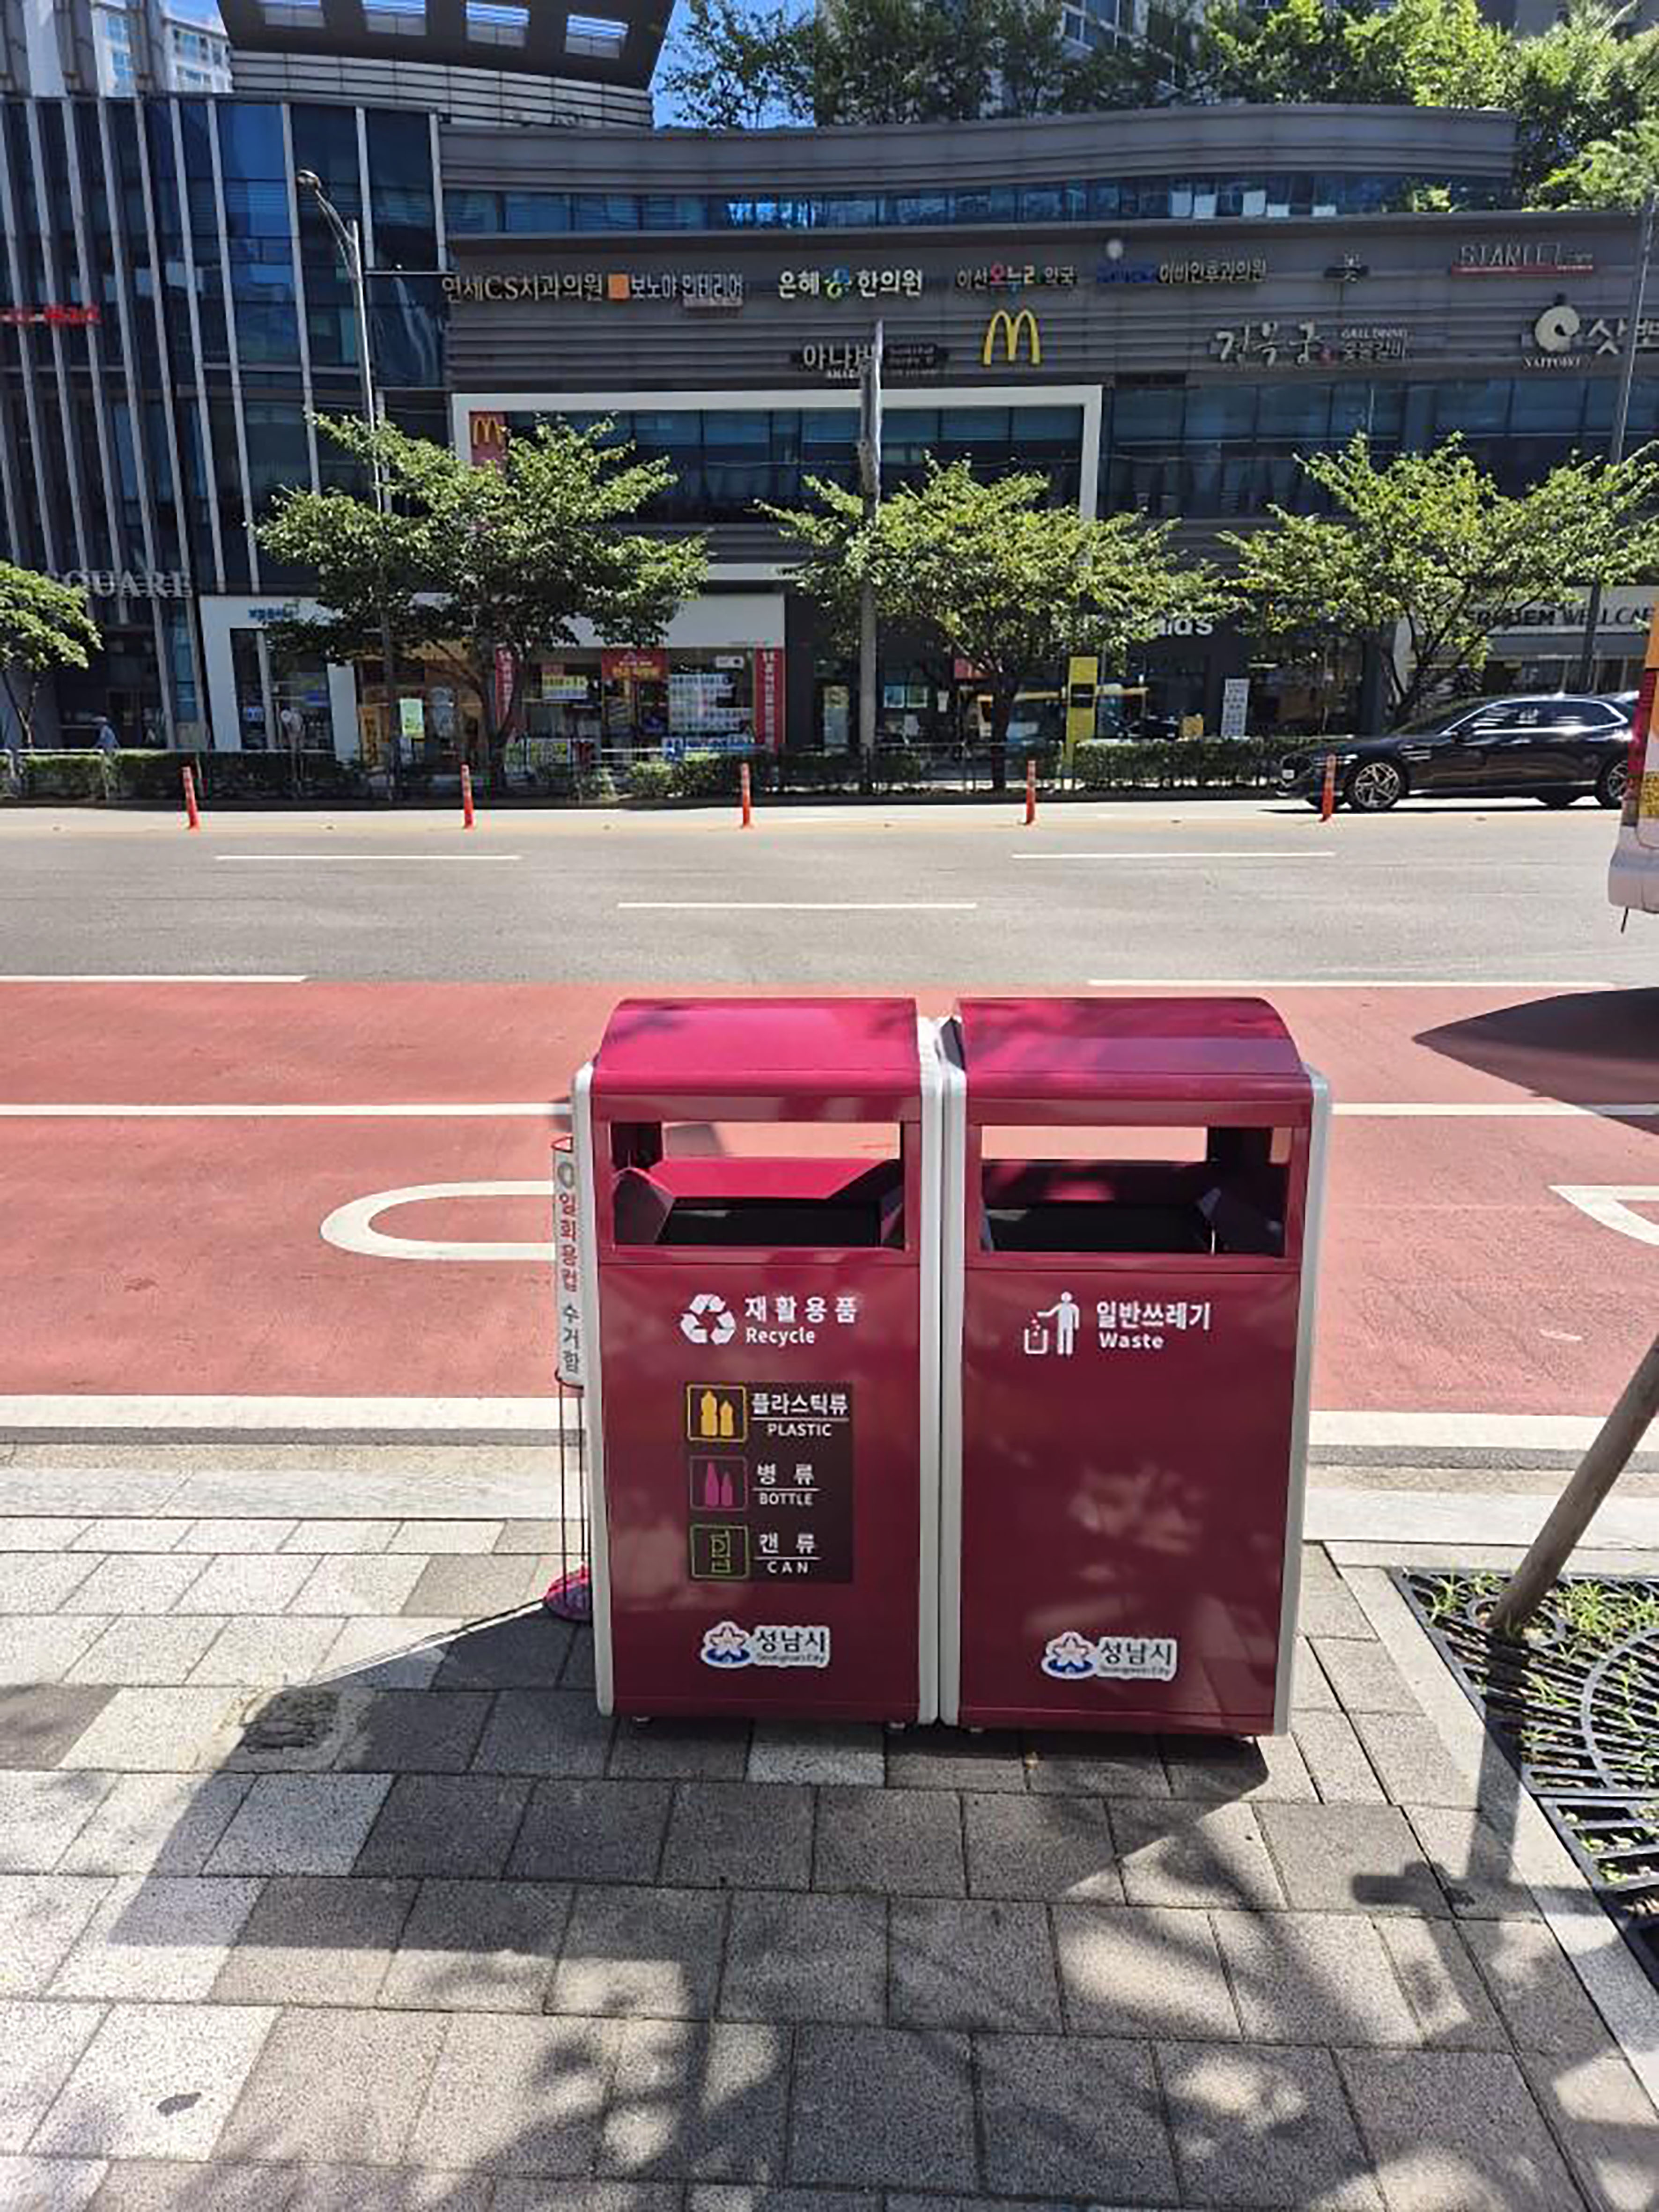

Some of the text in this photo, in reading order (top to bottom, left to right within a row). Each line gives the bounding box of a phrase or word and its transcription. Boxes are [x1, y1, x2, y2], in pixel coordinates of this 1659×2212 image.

[778, 269, 922, 298] 은혜 한의원
[1096, 1301, 1211, 1330] 일반쓰레기
[746, 1327, 815, 1348] Recycle
[1099, 1333, 1165, 1349] Waste
[751, 1393, 848, 1416] 플라스틱류
[767, 1423, 832, 1437] PLASTIC
[759, 1492, 813, 1506] BOTTLE
[767, 1562, 809, 1574] CAN
[756, 1630, 824, 1652] 성남시
[1101, 1641, 1171, 1666] 성남시
